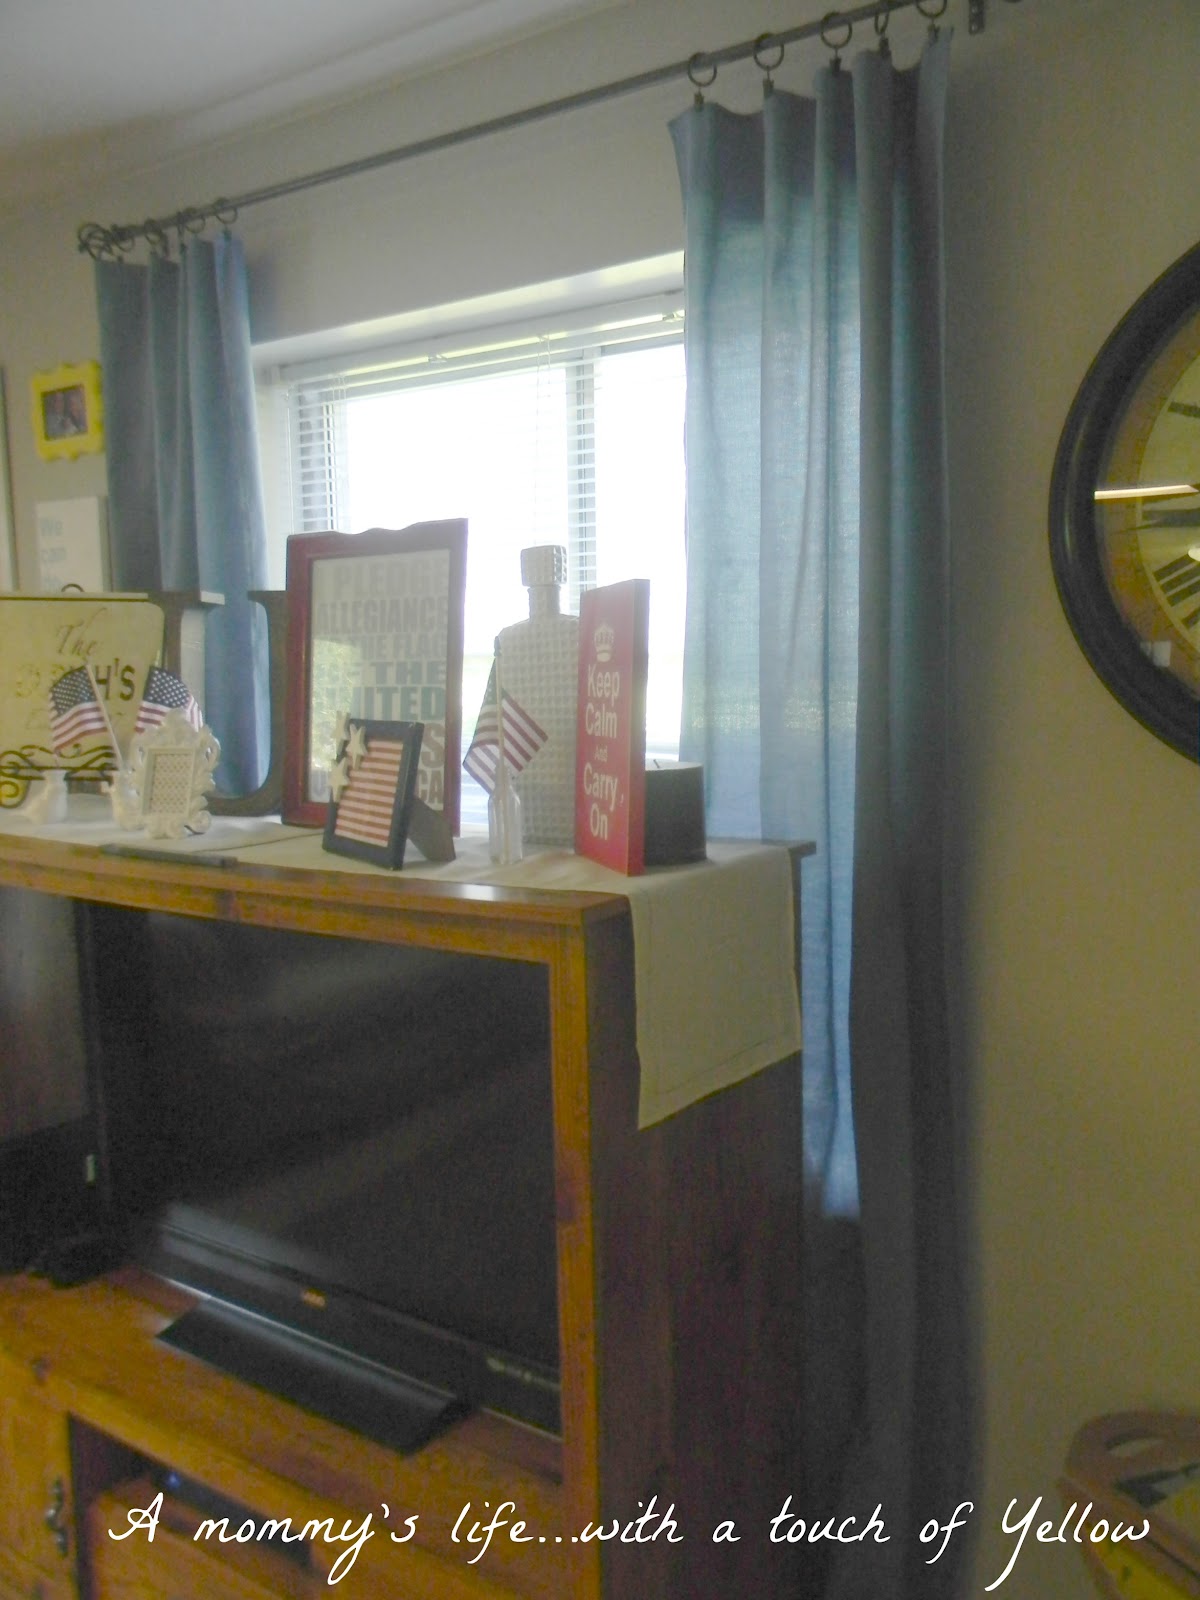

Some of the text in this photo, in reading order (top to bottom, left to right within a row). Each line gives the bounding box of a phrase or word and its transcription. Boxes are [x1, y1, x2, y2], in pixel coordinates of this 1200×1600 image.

[334, 560, 448, 600] PLEDGE
[57, 607, 108, 656] The
[317, 597, 447, 634] ALLEGIANCE
[392, 633, 447, 660] FLAG
[370, 662, 446, 684] THE
[587, 664, 620, 703] Keep
[585, 703, 618, 738] Calm
[589, 802, 608, 841] On
